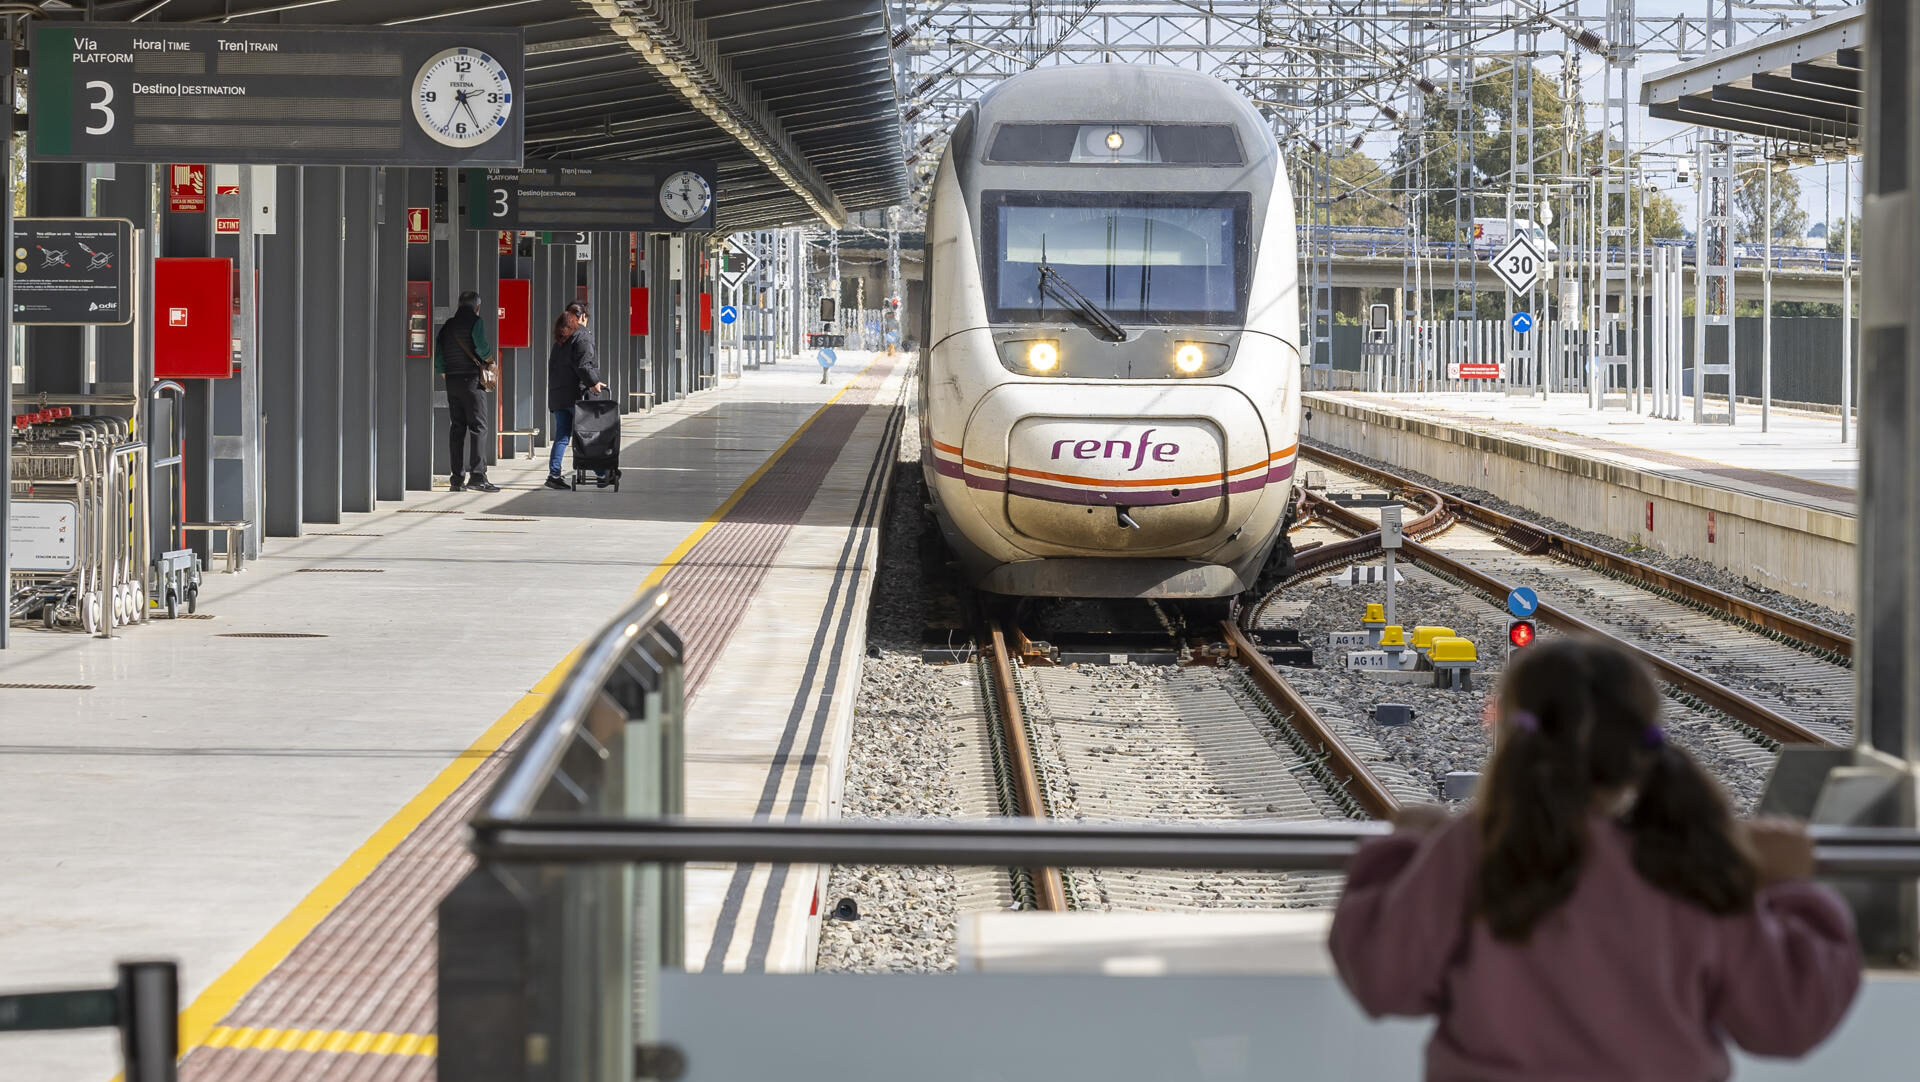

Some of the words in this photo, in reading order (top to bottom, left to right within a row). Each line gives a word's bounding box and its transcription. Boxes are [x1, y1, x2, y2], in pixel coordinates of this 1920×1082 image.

[72, 53, 134, 63] PLATFORM
[454, 61, 471, 73] 12
[425, 91, 437, 103] 9
[487, 92, 498, 104] 3
[85, 80, 115, 135] 3
[455, 122, 467, 134] 6
[492, 188, 509, 217] 3
[218, 221, 239, 229] EXTINT
[739, 262, 746, 272] 3
[1509, 256, 1533, 274] 30
[1051, 429, 1180, 471] renfe
[1336, 636, 1349, 645] AG
[1351, 636, 1364, 645] 1.2
[1353, 656, 1367, 666] AG
[1370, 656, 1383, 666] 1.1
